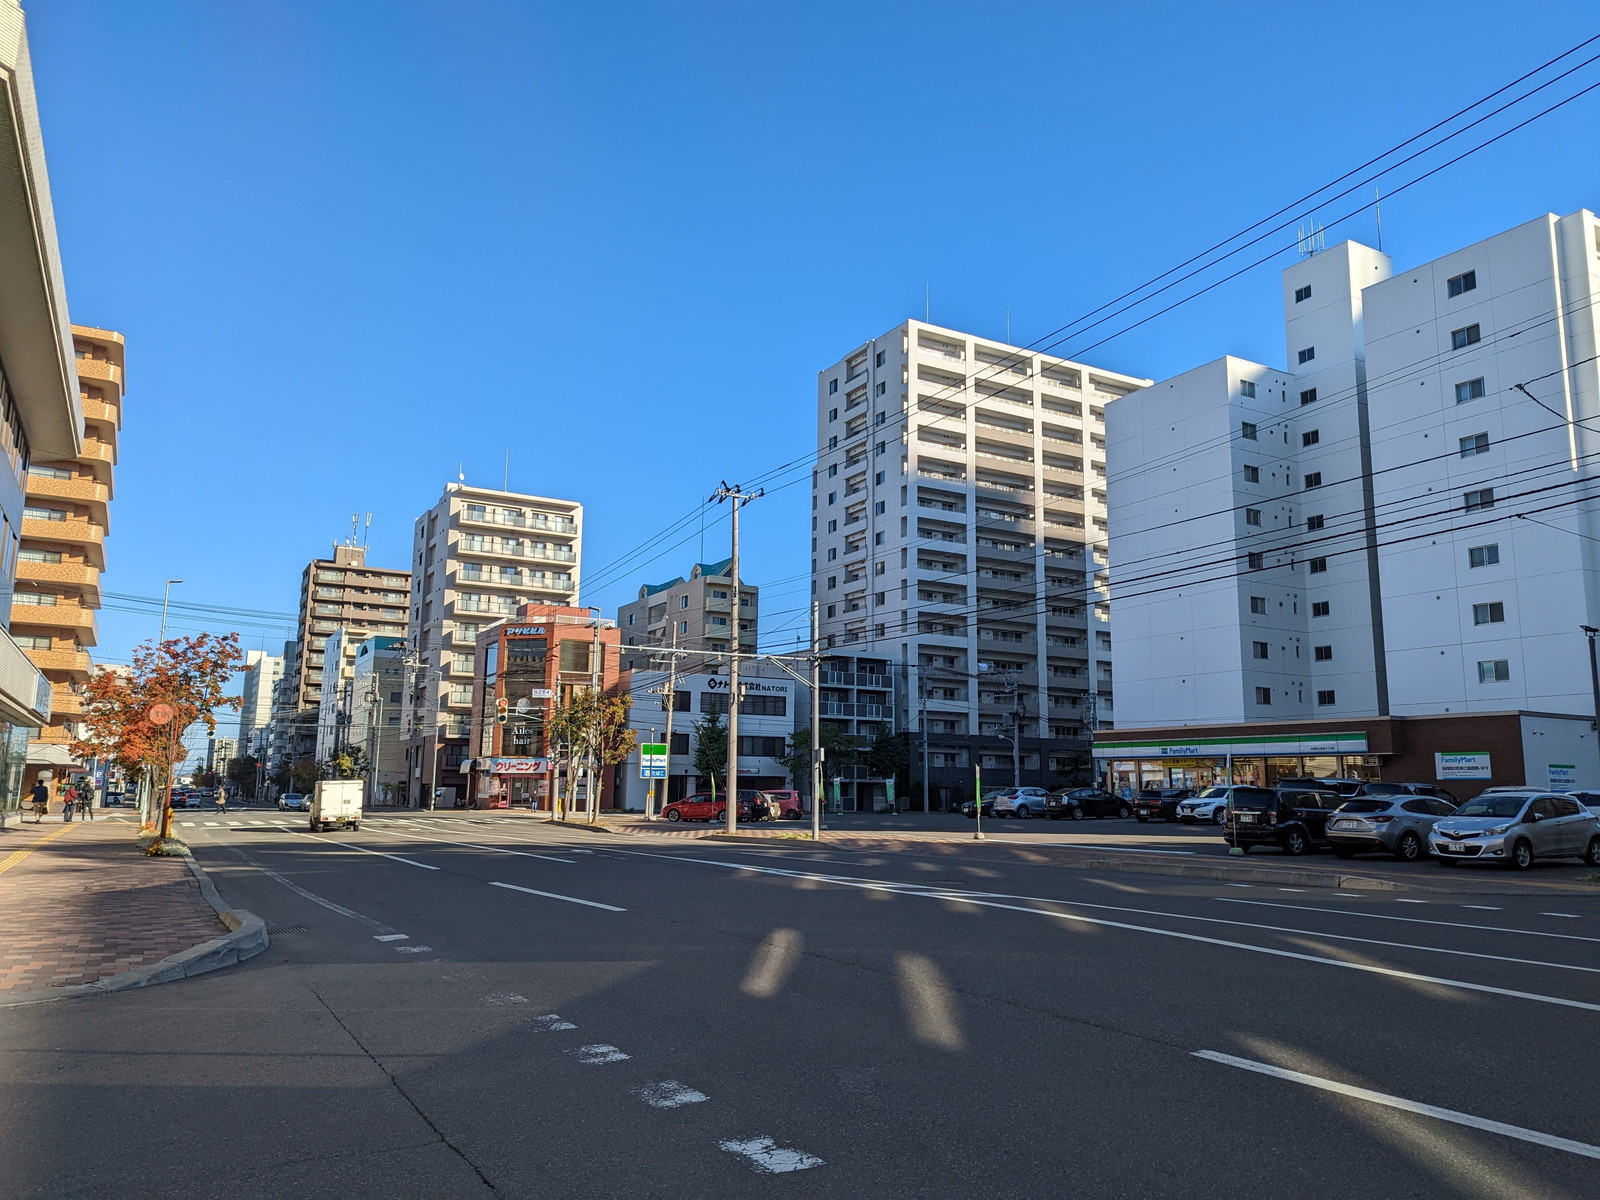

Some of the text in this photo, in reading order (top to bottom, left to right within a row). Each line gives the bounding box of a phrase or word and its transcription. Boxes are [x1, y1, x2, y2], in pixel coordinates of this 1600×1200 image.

[762, 684, 788, 693] NATORI
[512, 726, 534, 735] Ailes
[513, 736, 531, 745] hair
[1169, 747, 1199, 755] FamilyMart
[1441, 756, 1476, 764] FamilyMart
[495, 761, 542, 772] クリーニング
